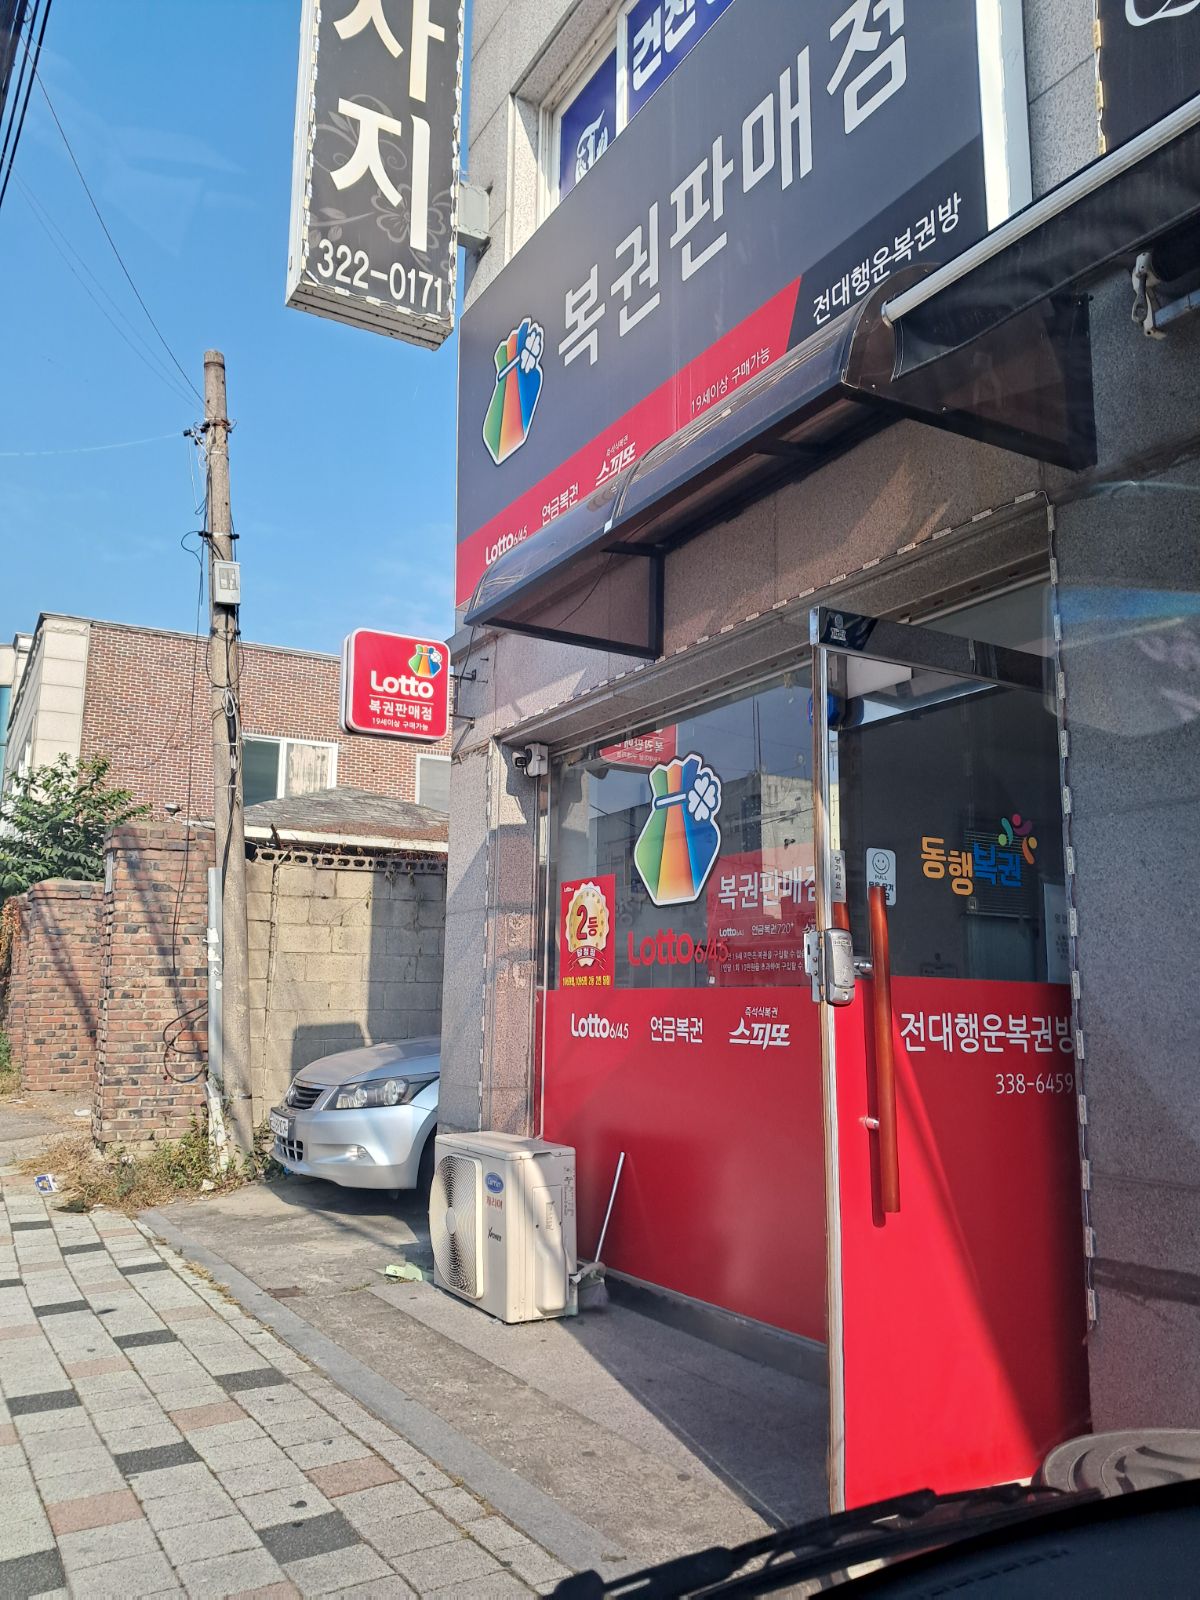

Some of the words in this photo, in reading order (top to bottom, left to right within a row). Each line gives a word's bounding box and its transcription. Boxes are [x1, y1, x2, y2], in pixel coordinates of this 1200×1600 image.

[559, 0, 907, 367] 복권판매점
[317, 238, 442, 312] 322-0171
[812, 191, 962, 325] 전대행운복권방
[692, 375, 728, 414] 19세이상
[732, 347, 770, 384] 구매가능
[595, 442, 636, 487] 스피또
[541, 482, 578, 526] 연금복권
[371, 670, 434, 698] Lotto
[369, 699, 432, 721] 복권판매점
[372, 717, 400, 727] 19세이상
[403, 720, 428, 731] 구매가능
[576, 904, 599, 940] 2등
[745, 1006, 778, 1018] 즉석식복권
[571, 1013, 629, 1040] Lotto6/45
[650, 1016, 703, 1044] 연금복권
[729, 1017, 791, 1050] 스피또
[995, 1073, 1074, 1095] 338-6459
